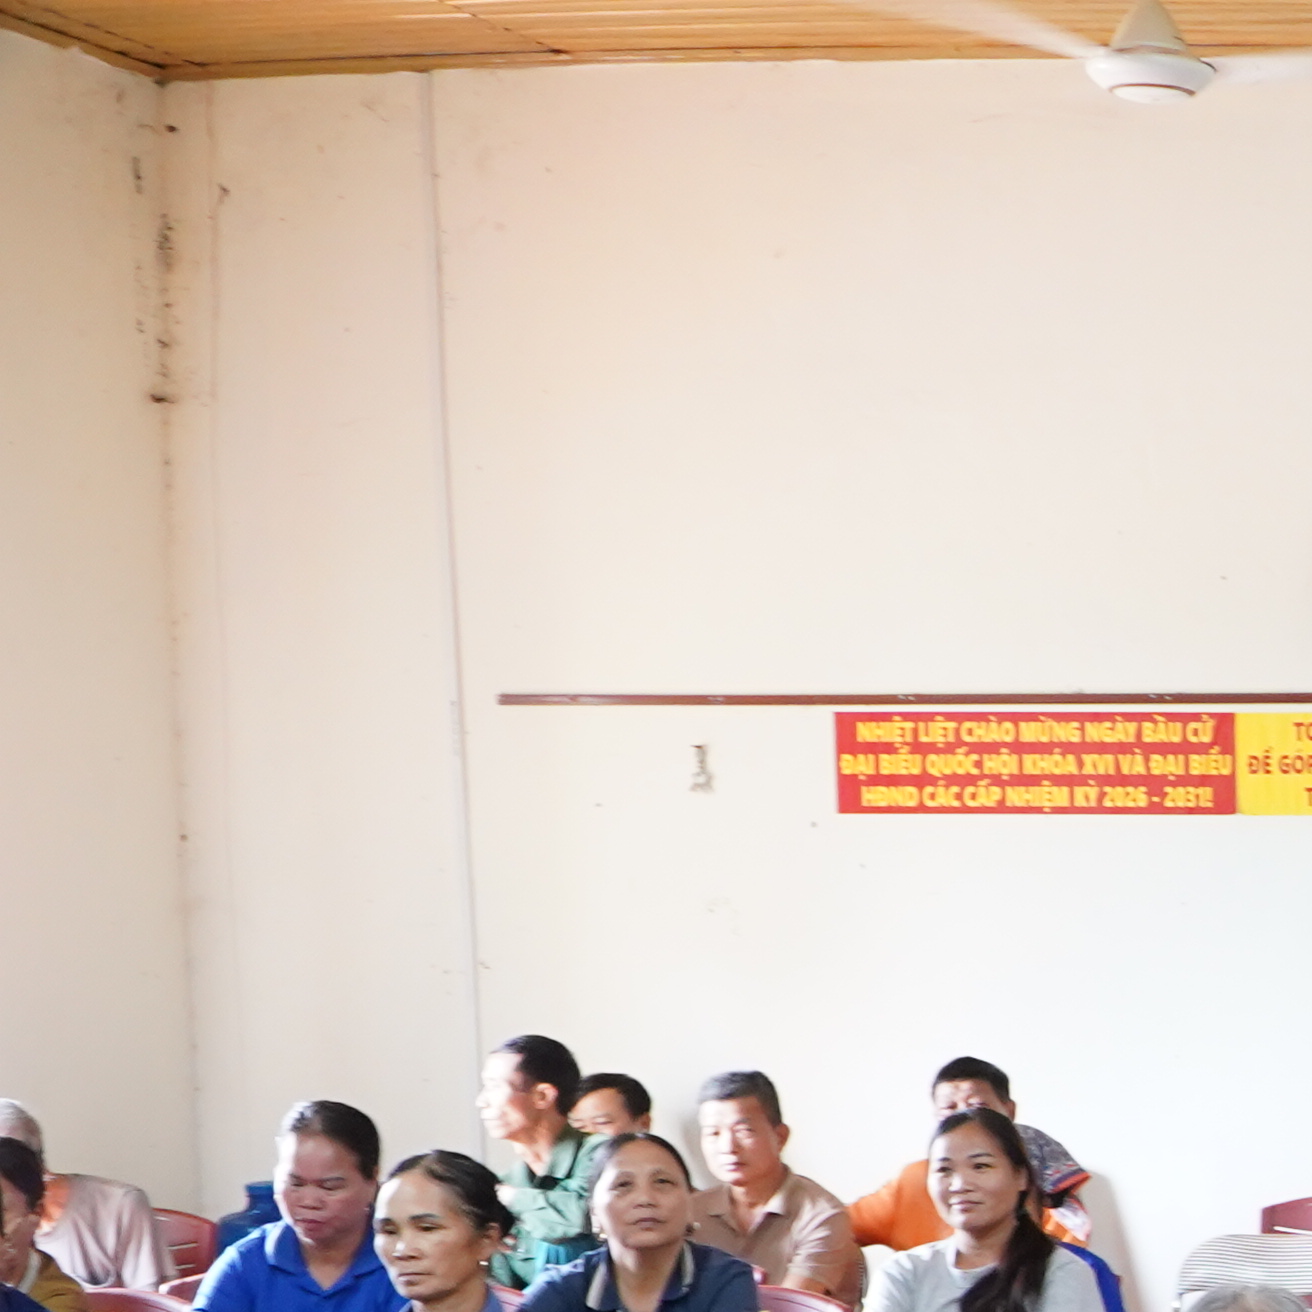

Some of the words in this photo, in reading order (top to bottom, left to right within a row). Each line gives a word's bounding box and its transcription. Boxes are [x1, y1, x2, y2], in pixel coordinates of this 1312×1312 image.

[856, 716, 916, 747] NHIỆT
[917, 716, 959, 747] LIỆT
[960, 716, 1017, 743] CHÀO
[1018, 715, 1083, 743] MỪNG
[1084, 715, 1139, 743] NGÀY
[1141, 715, 1184, 743] BẦU
[1185, 715, 1217, 743] CỬ
[839, 753, 877, 780] ĐẠI
[878, 745, 924, 775] BIỂU
[924, 746, 981, 777] QUỐC
[982, 747, 1021, 780] HỘI
[1021, 747, 1080, 775] KHÓA
[1080, 753, 1116, 775] XVI
[1116, 747, 1148, 775] VÀ
[1148, 753, 1186, 780] ĐẠI
[1188, 745, 1234, 775] BIỂU
[1247, 746, 1274, 774] ĐỂ
[921, 779, 962, 807] CÁC
[962, 778, 1003, 807] CẤP
[1004, 780, 1071, 812] NHIỆM
[1072, 779, 1101, 807] KỲ
[1101, 786, 1149, 807] 2026
